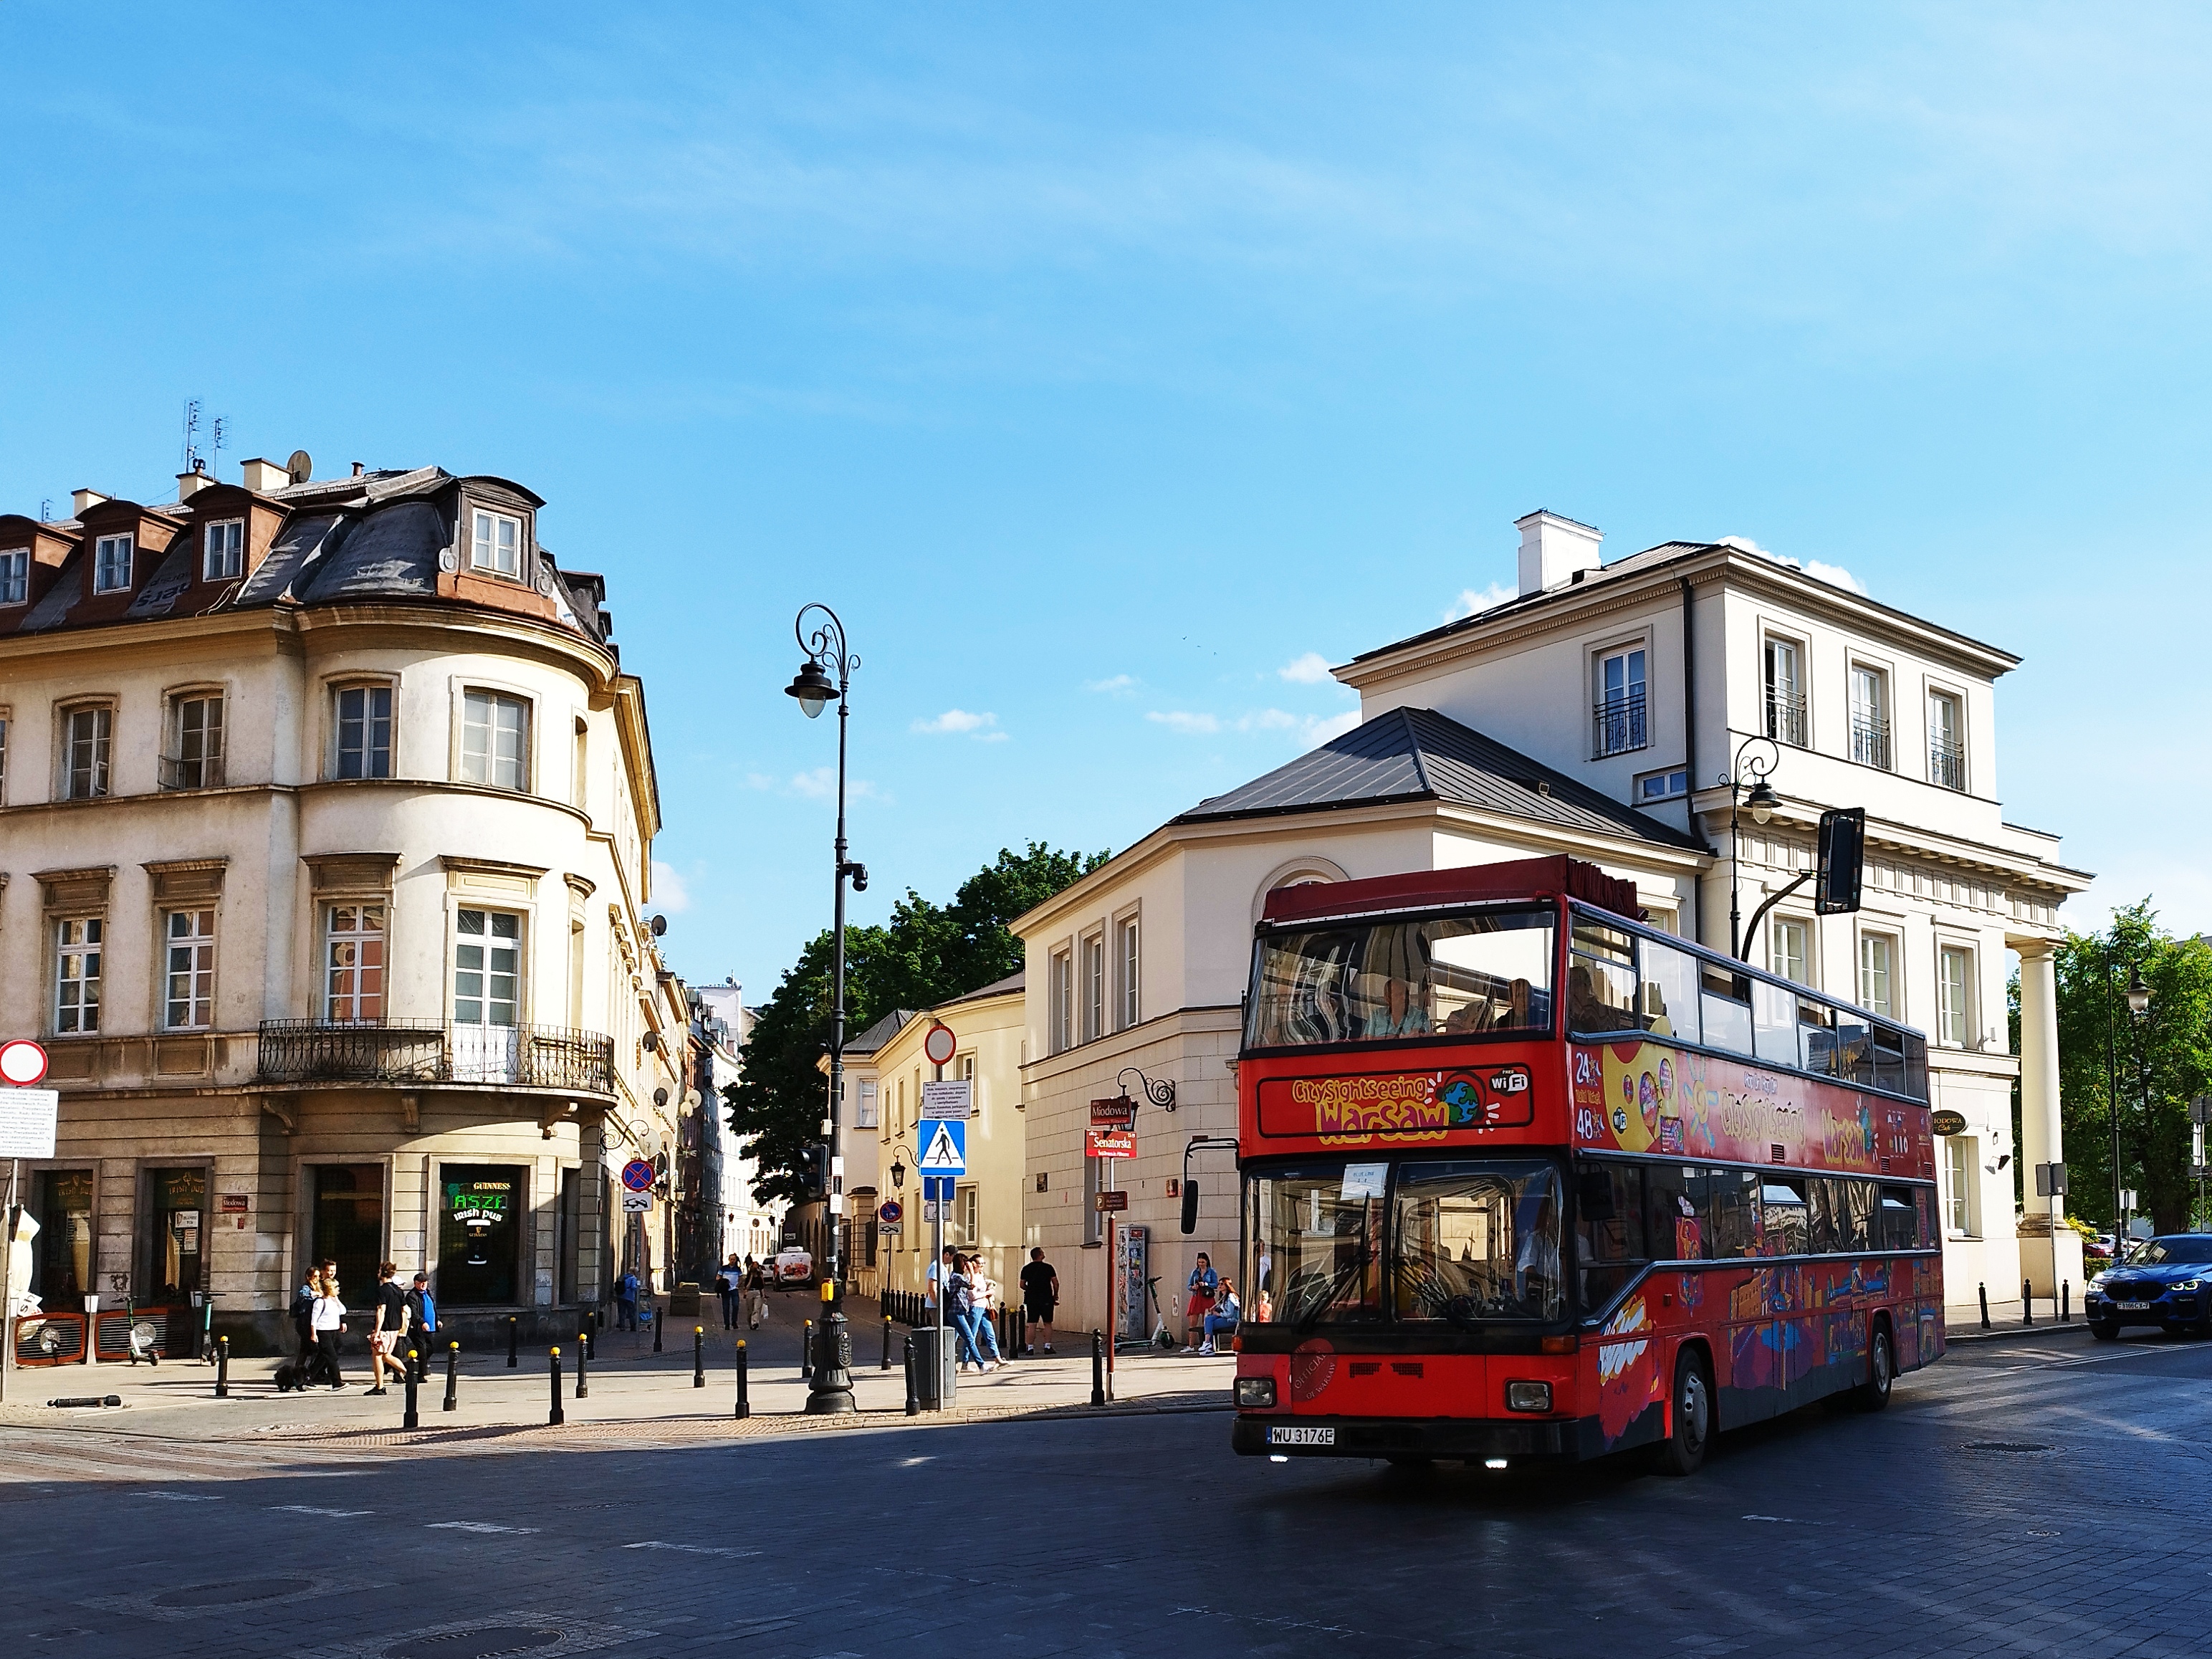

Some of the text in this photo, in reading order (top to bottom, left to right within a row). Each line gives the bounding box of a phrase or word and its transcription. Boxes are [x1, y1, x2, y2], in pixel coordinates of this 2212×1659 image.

[1576, 1051, 1591, 1084] 24
[1292, 1076, 1428, 1104] CitySightseeing
[1092, 1104, 1128, 1117] Miodowa
[1316, 1100, 1449, 1144] Warsaw
[1577, 1108, 1593, 1139] 48
[1093, 1137, 1132, 1149] Senatorska
[1294, 1353, 1327, 1389] OFFICIAL
[1316, 1362, 1336, 1393] WARSAW
[1273, 1429, 1333, 1443] WU 3176E
